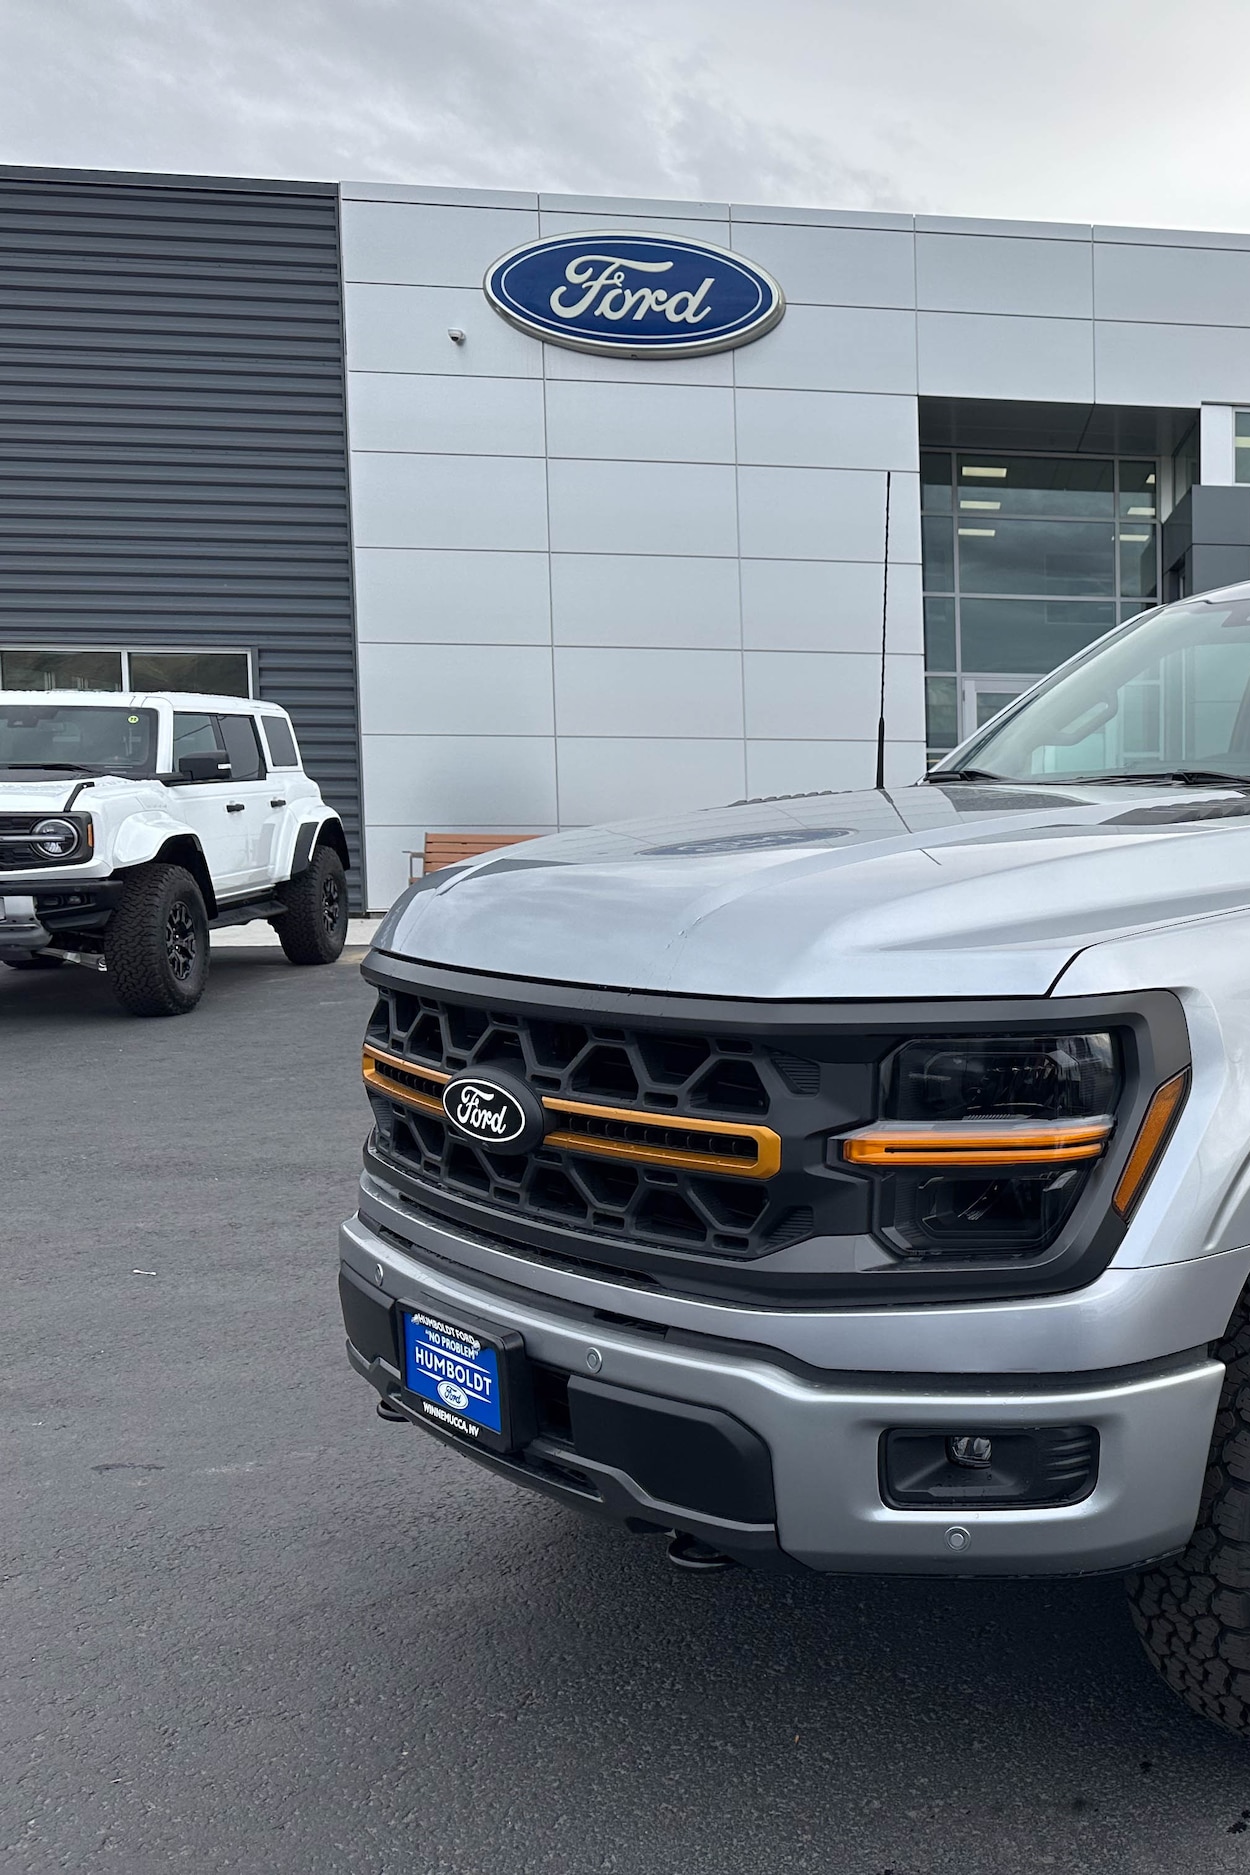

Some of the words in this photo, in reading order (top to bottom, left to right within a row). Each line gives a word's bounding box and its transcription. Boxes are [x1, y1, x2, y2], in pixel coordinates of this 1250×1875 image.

[550, 255, 715, 324] Ford
[457, 1086, 507, 1134] Ford
[418, 1313, 456, 1338] HUMBOLDT
[455, 1329, 475, 1346] FORD
[415, 1346, 492, 1396] HUMBOLDT
[444, 1385, 463, 1405] Ford
[422, 1402, 468, 1434] WINNEMUCCA,
[469, 1424, 480, 1438] NV
